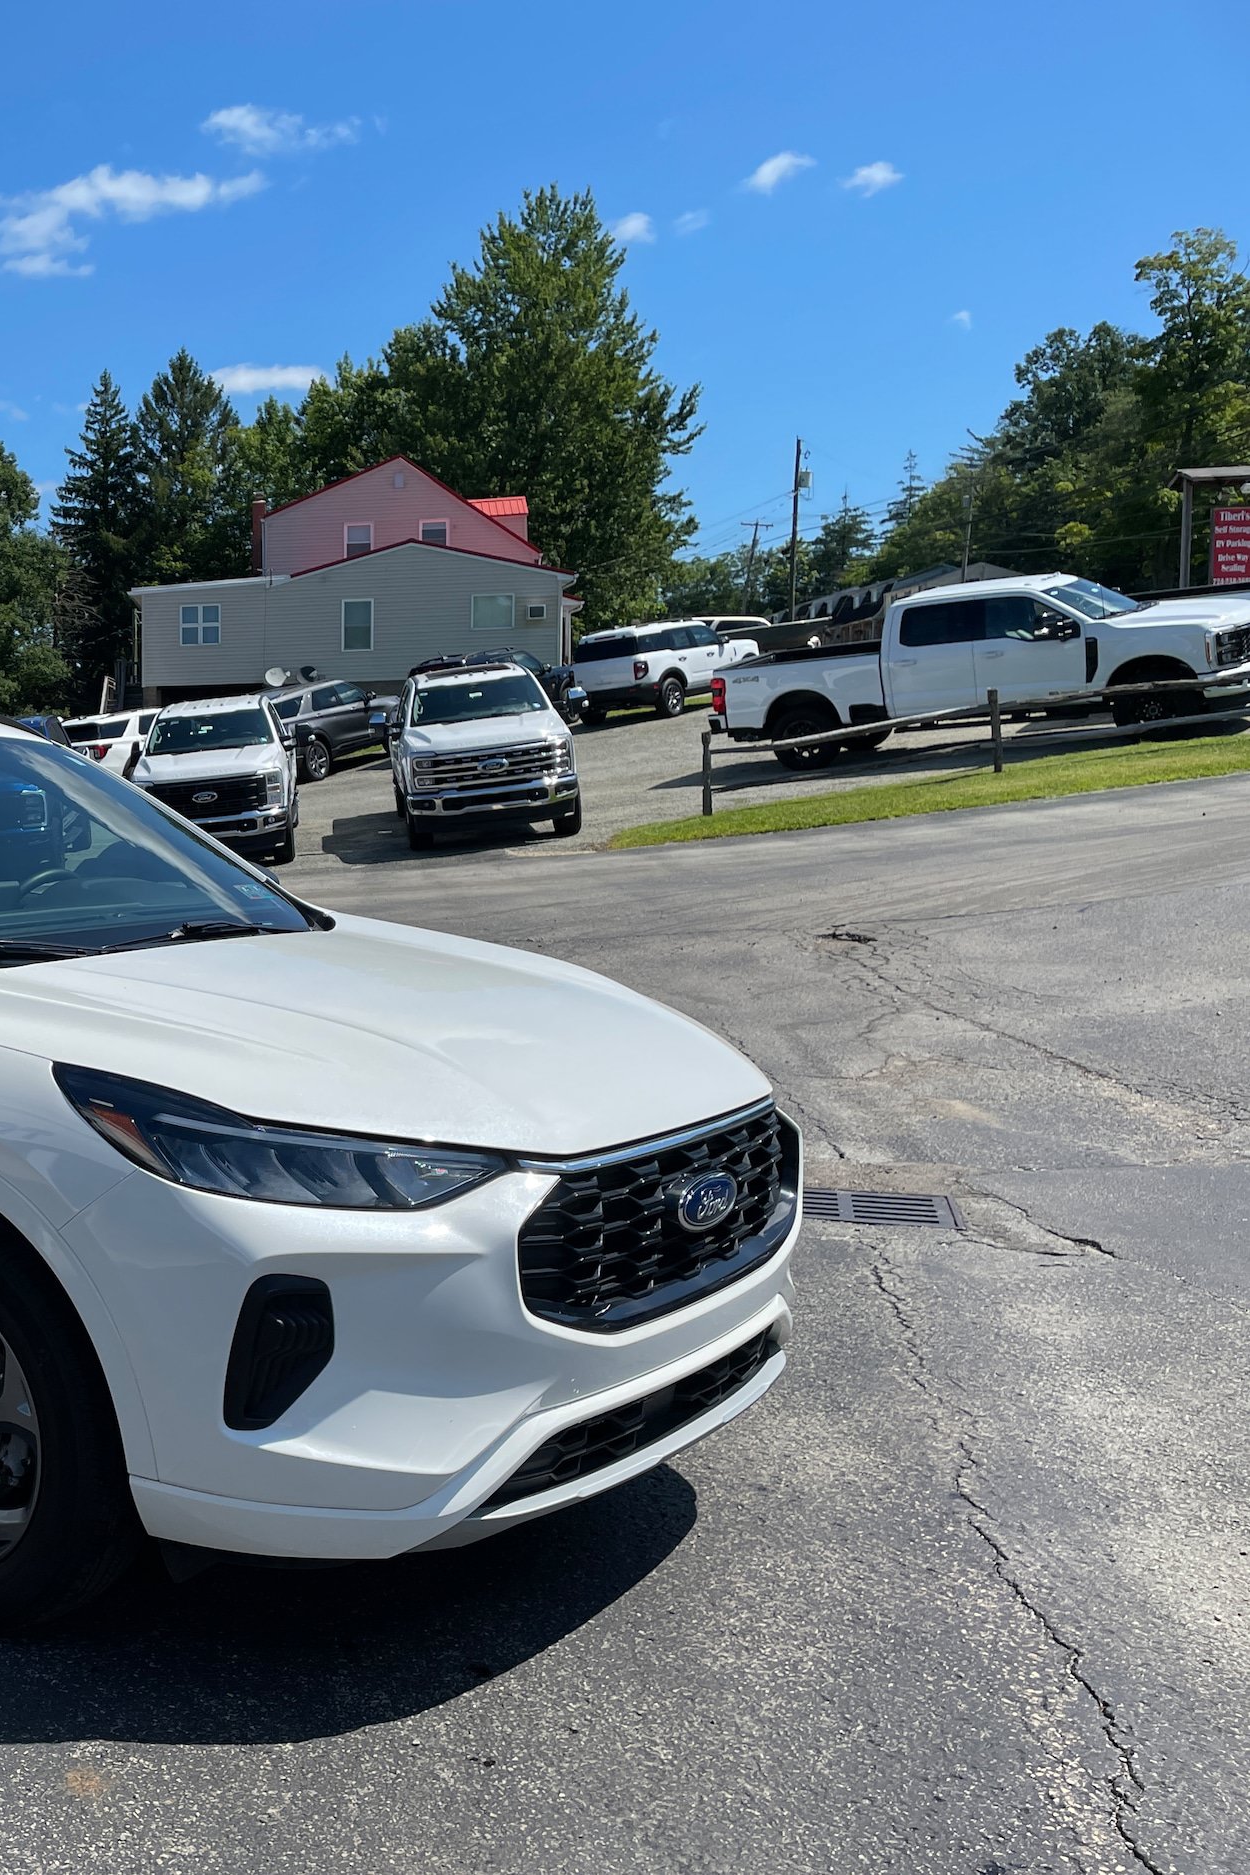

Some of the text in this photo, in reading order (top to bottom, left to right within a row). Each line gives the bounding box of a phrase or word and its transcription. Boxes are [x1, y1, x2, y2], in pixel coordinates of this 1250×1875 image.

[1218, 553, 1248, 562] Drive Way
[697, 1184, 729, 1220] Ford
